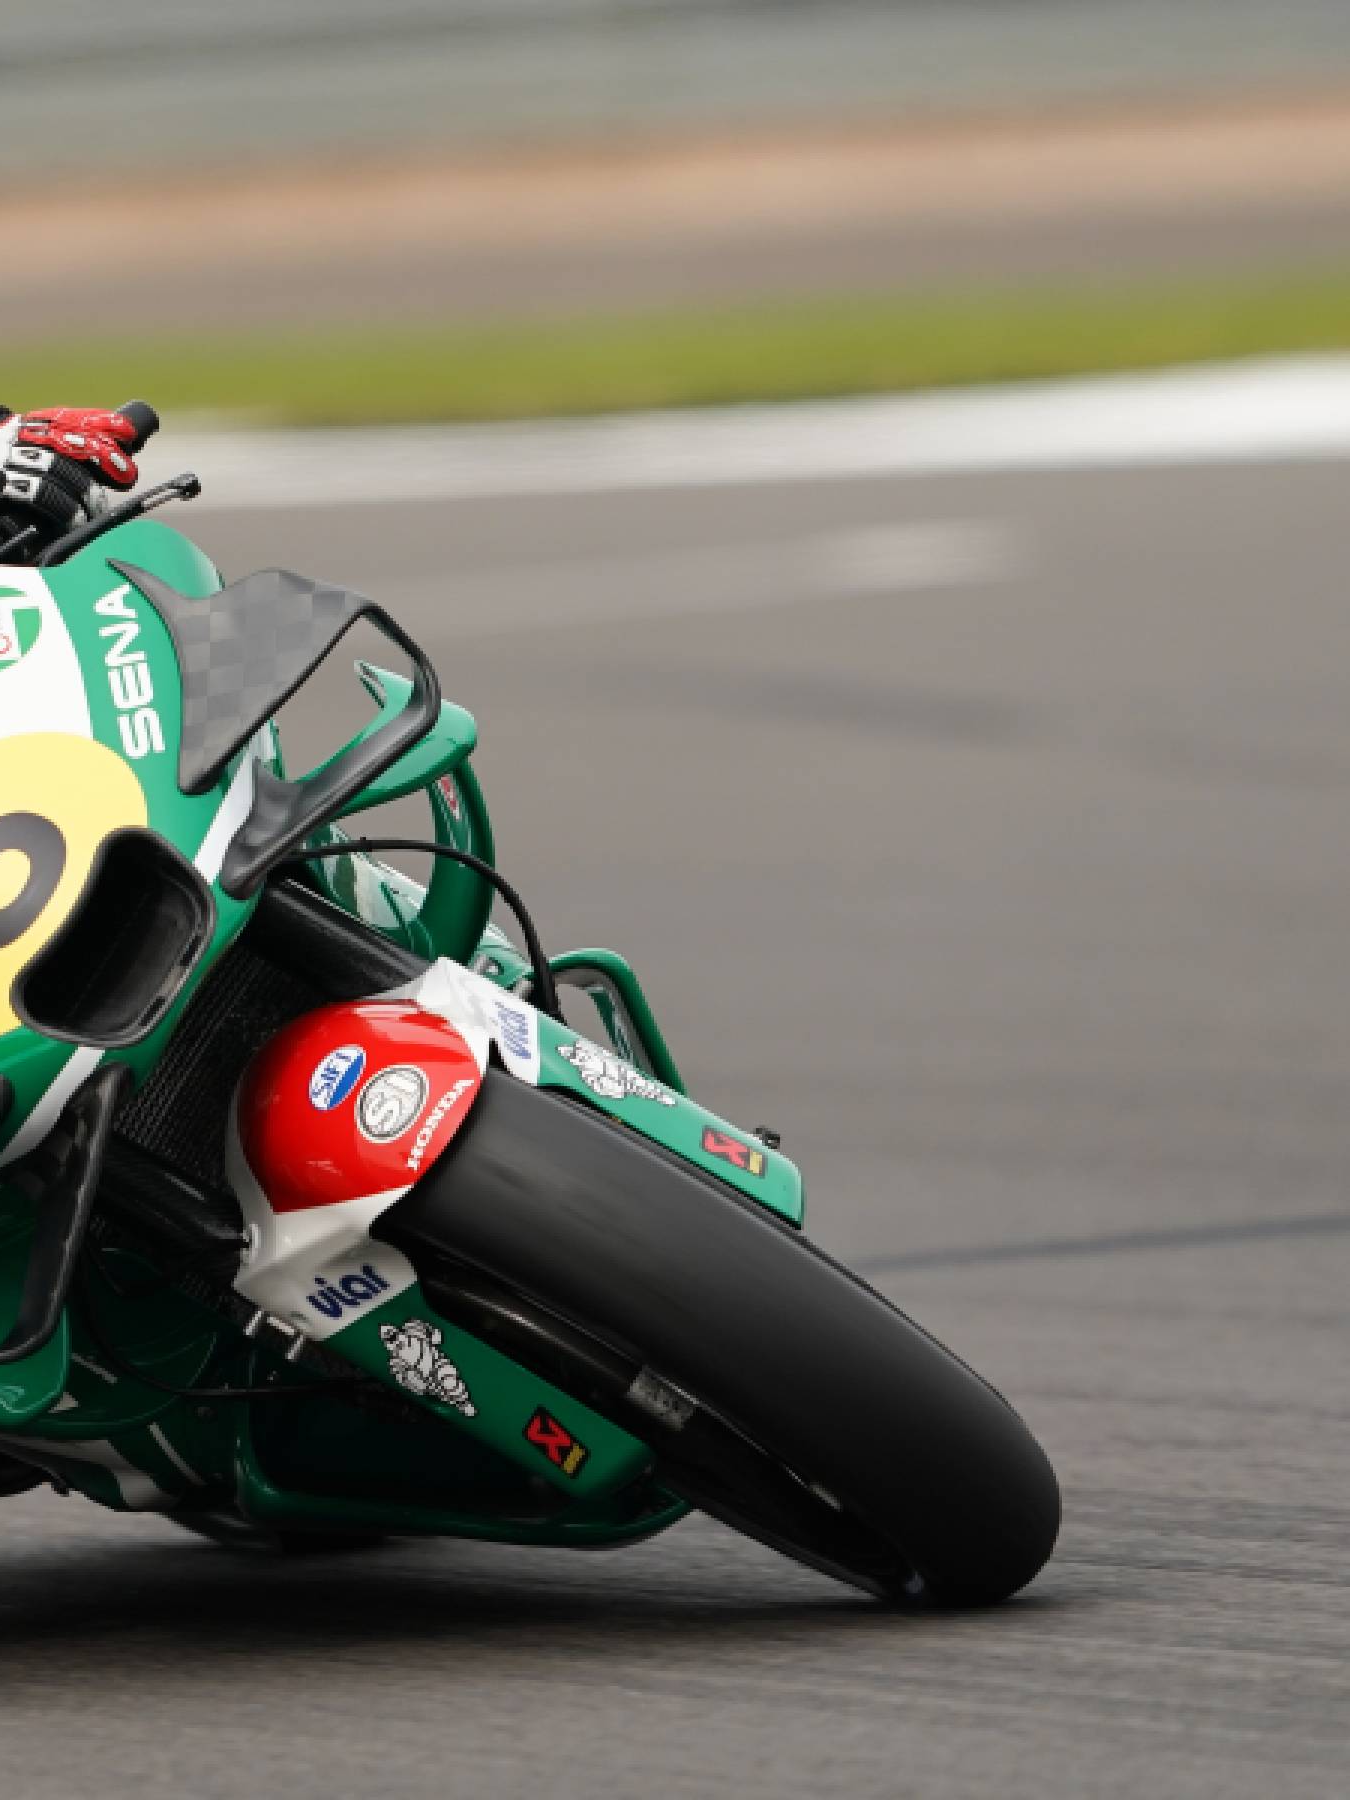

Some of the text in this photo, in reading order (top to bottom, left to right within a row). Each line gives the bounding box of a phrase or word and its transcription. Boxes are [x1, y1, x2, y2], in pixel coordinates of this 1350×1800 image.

[97, 582, 165, 759] SENA
[406, 1079, 474, 1170] HONDA
[307, 1265, 391, 1319] viar
